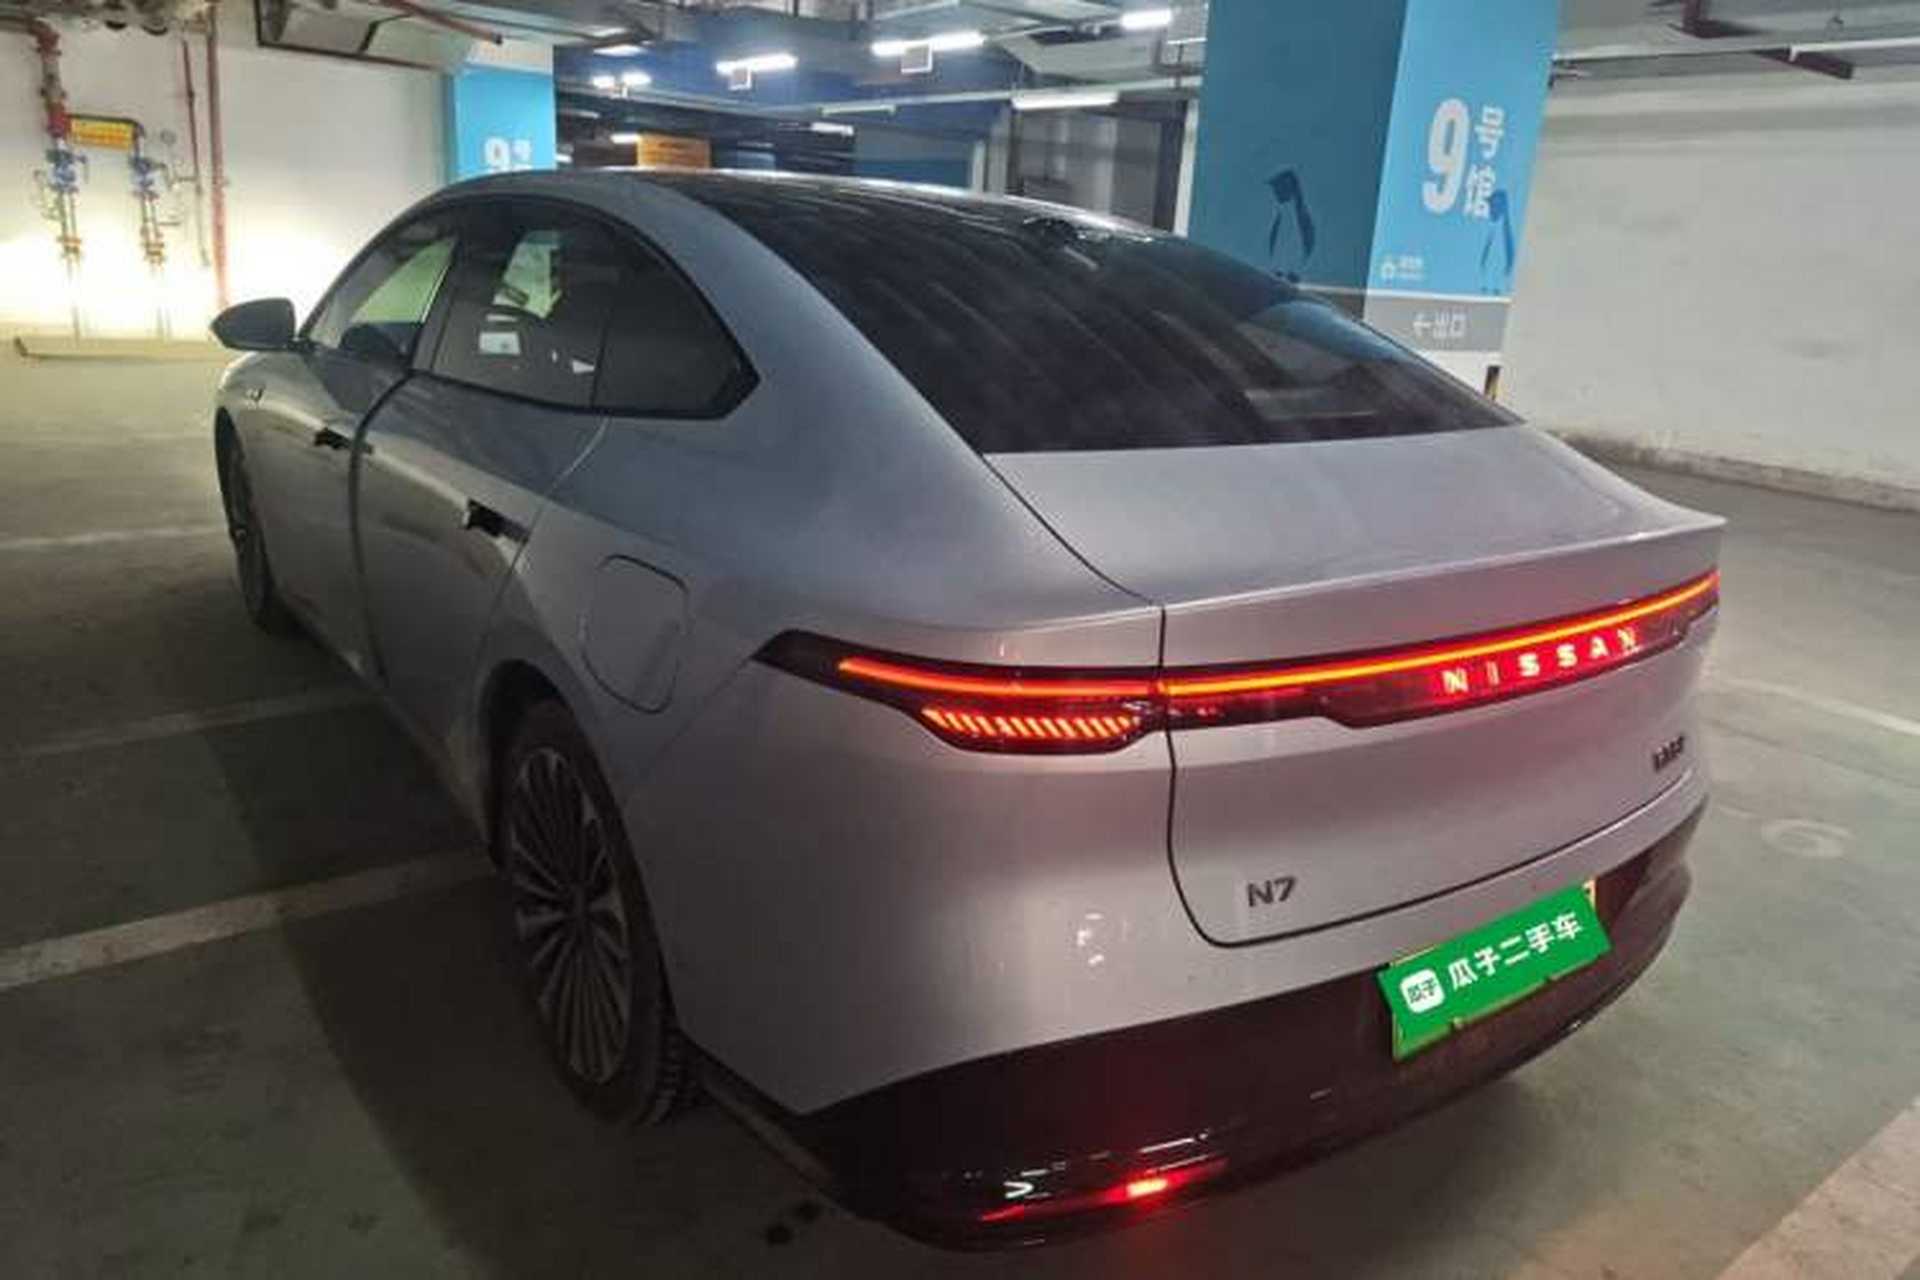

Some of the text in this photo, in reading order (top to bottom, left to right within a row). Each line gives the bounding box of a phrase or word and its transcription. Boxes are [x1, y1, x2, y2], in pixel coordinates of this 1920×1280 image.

[1422, 98, 1470, 214] 9
[1441, 626, 1638, 694] NISSAN
[1247, 875, 1297, 907] N7
